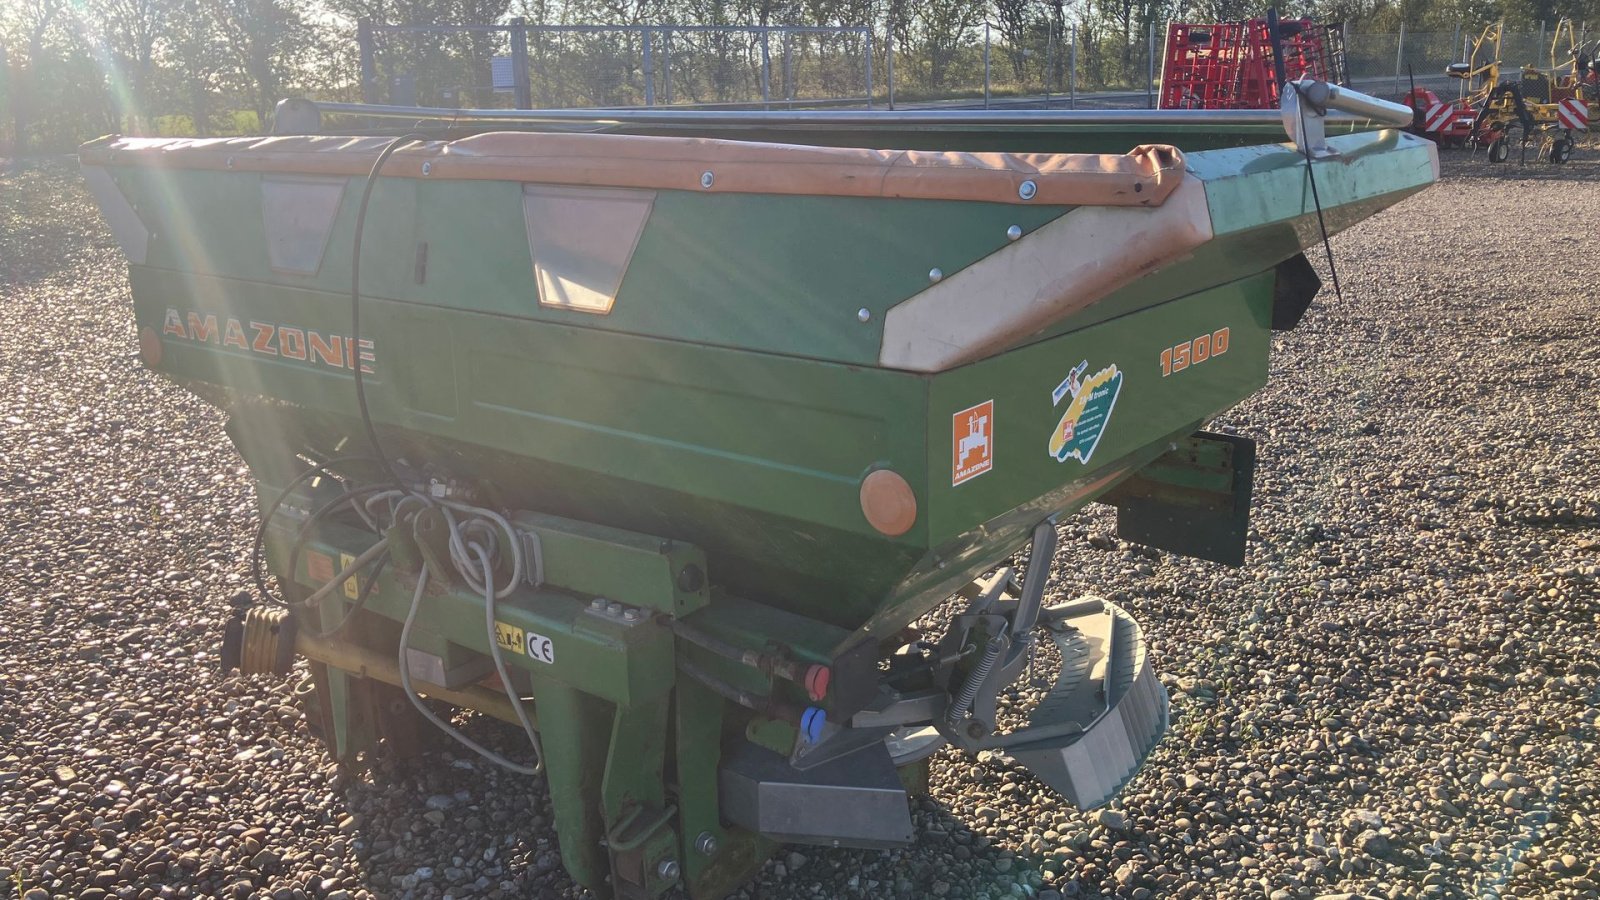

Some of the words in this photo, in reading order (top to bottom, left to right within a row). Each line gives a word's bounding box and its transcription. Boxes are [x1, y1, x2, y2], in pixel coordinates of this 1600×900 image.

[163, 307, 376, 375] AMAZONE
[1160, 327, 1230, 378] 1500
[954, 459, 990, 481] AMAZONE
[529, 636, 552, 662] CE
